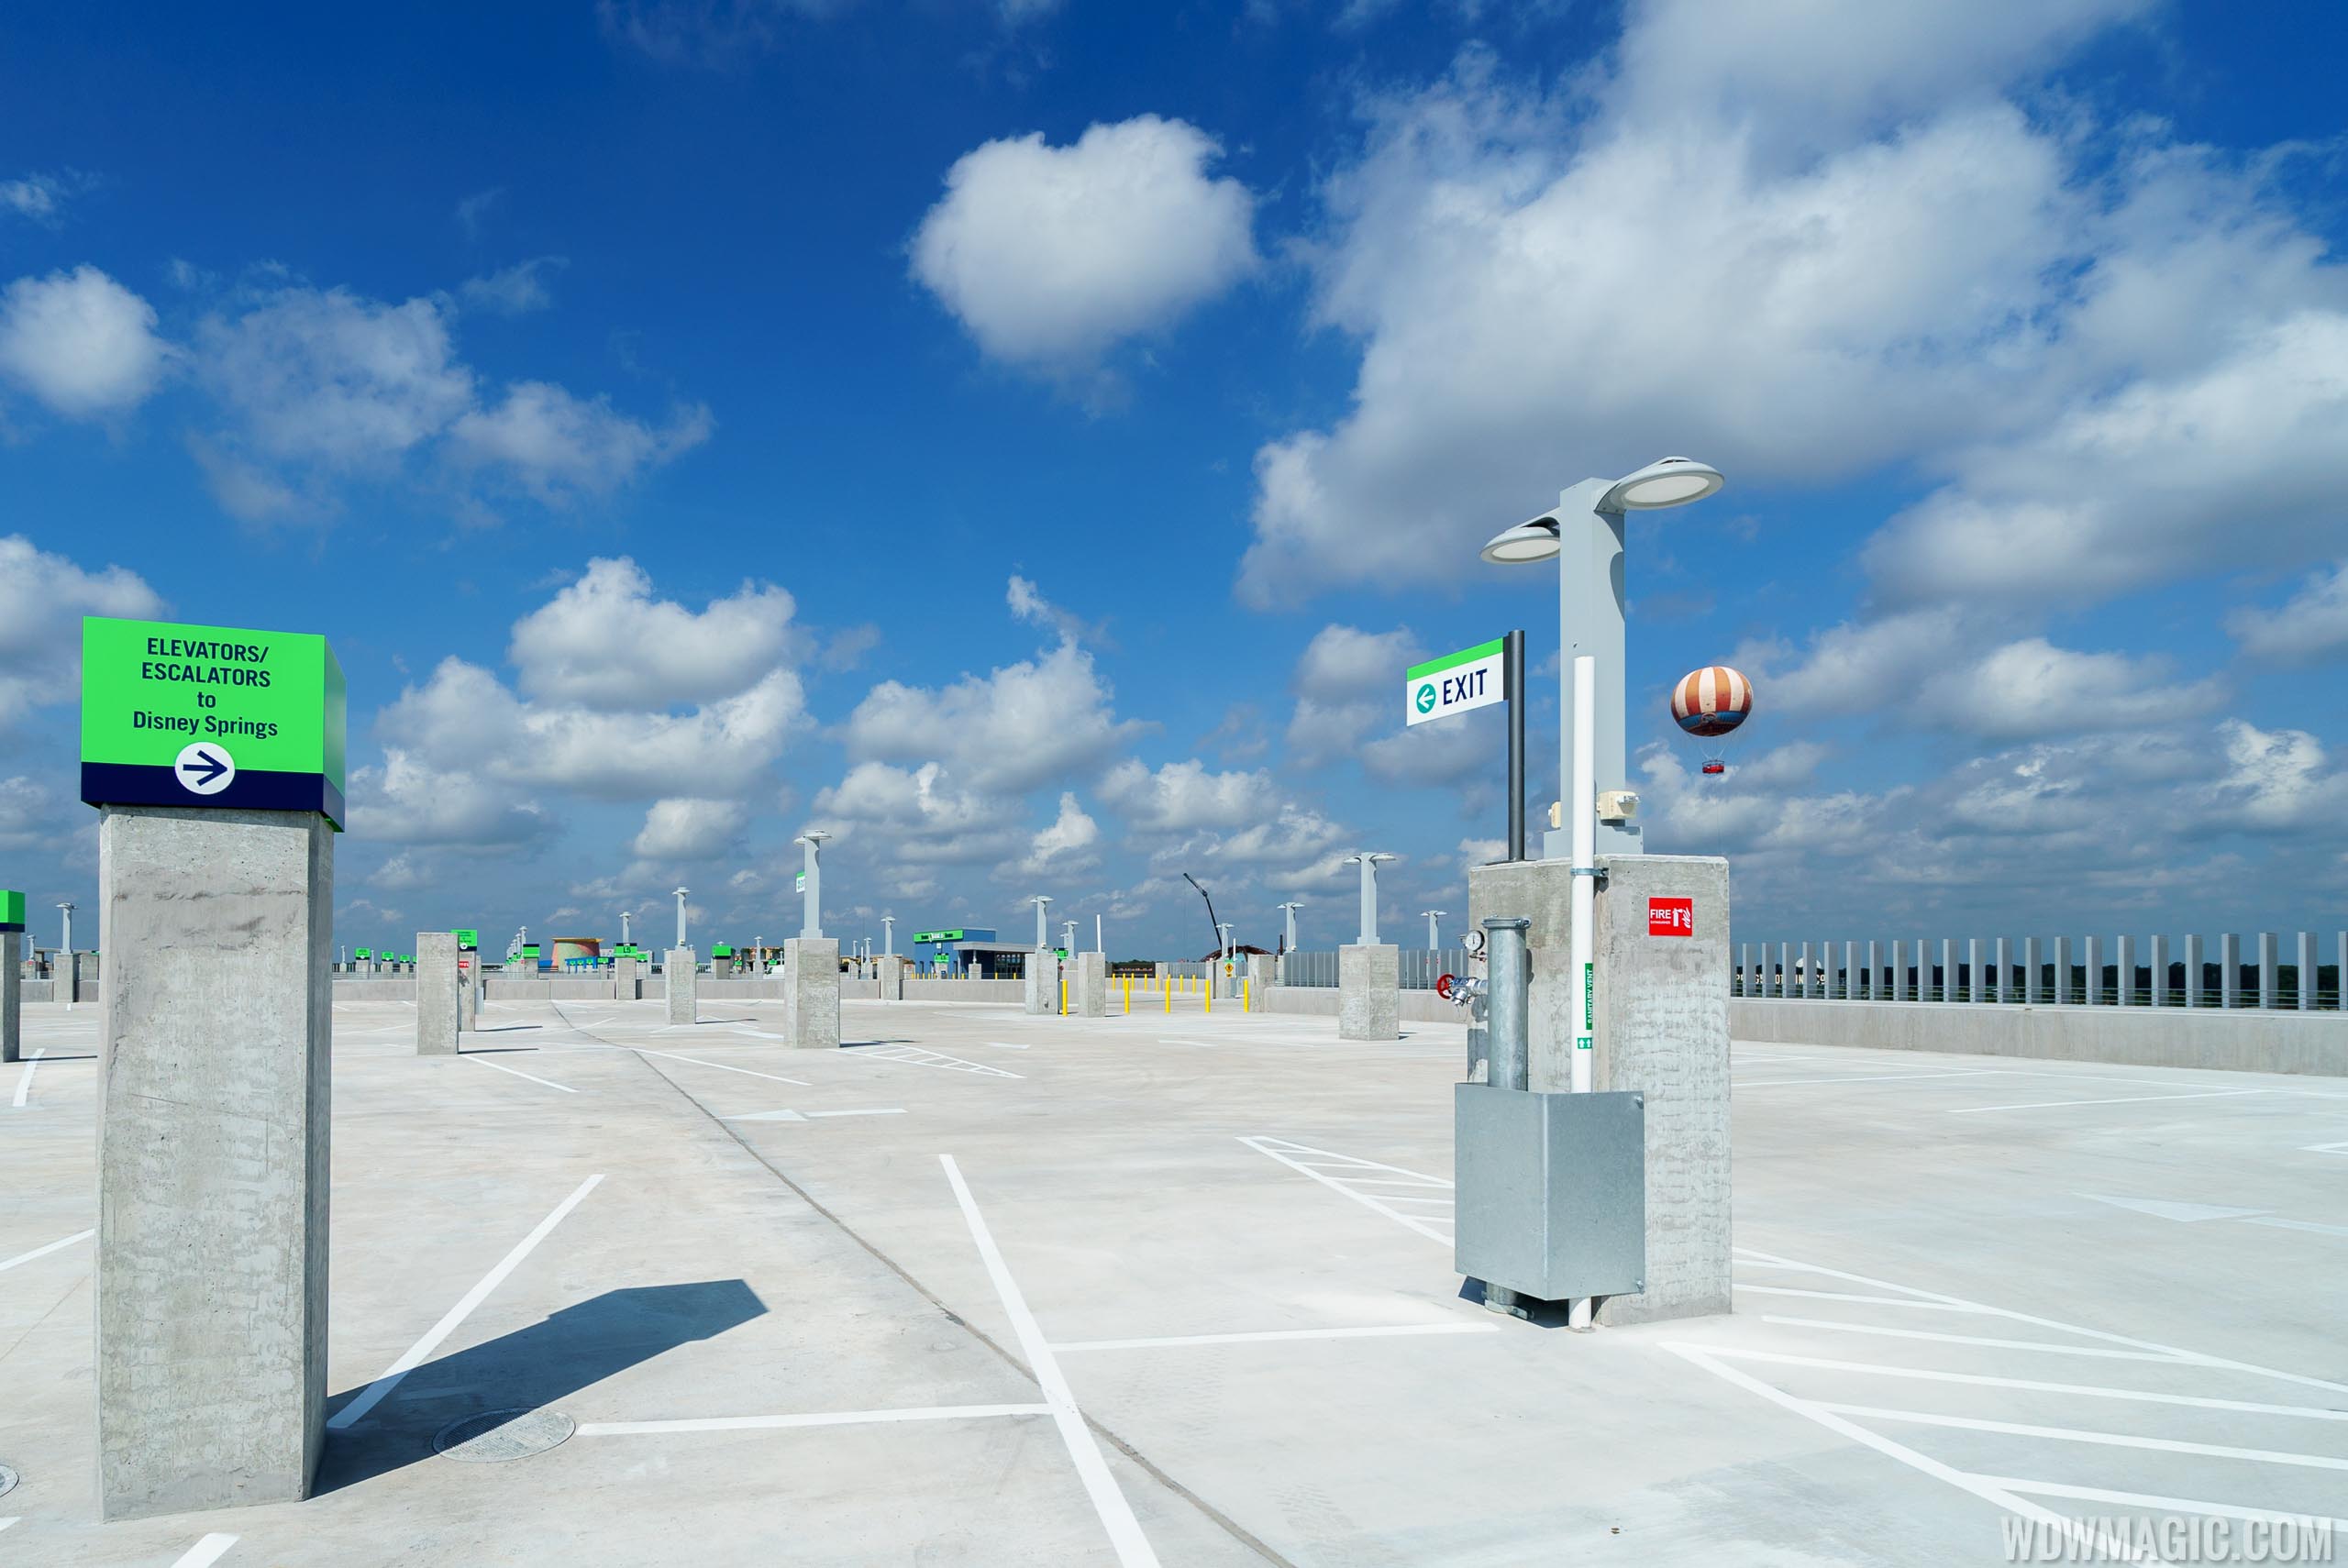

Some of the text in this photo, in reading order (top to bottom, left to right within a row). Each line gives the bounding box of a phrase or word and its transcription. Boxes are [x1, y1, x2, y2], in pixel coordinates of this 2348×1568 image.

[147, 637, 269, 663] ELEVATORS/
[141, 662, 271, 688] ESCALATORS
[1443, 668, 1488, 705] EXIT
[197, 691, 216, 708] to
[133, 711, 278, 739] Disney Springs
[1650, 909, 1671, 919] FIRE
